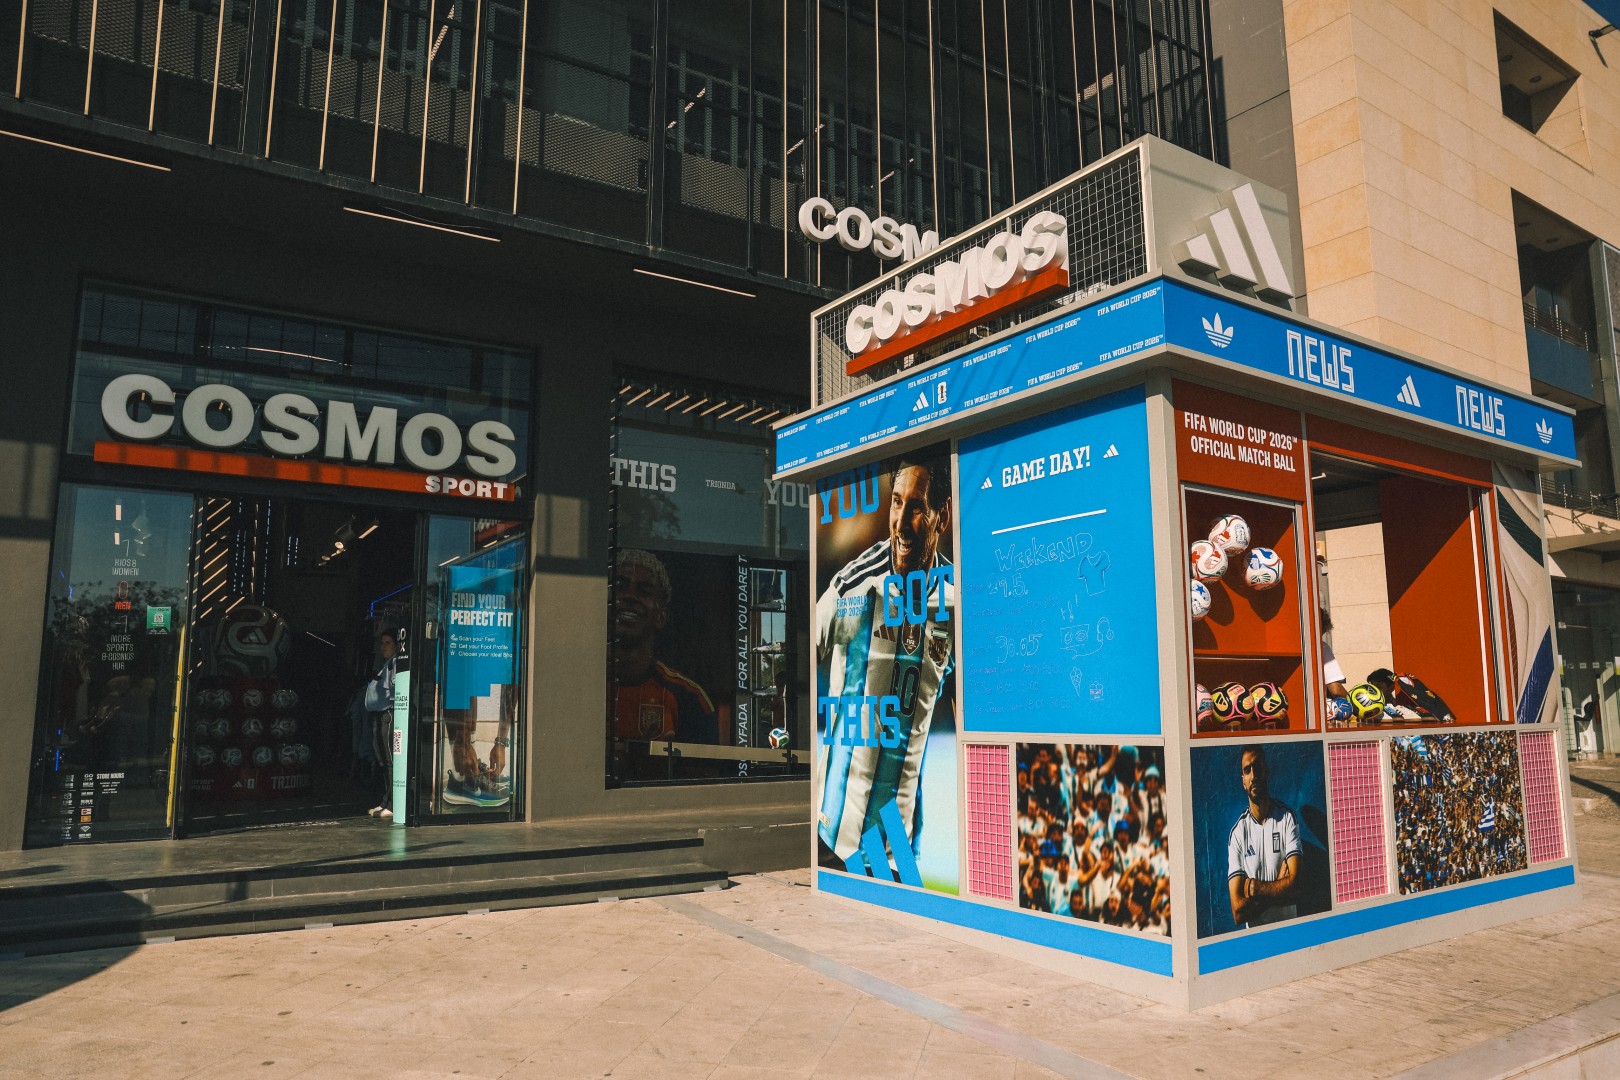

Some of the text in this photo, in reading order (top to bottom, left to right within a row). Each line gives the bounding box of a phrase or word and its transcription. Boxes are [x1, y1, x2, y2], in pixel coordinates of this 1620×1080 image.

[798, 196, 958, 261] COSM
[846, 210, 1069, 354] COSMOS
[1097, 305, 1109, 316] FIFA
[1110, 297, 1129, 311] WORLD
[1130, 293, 1140, 304] CUP
[1025, 333, 1036, 344] FIFA
[1037, 327, 1053, 339] WORLD
[1054, 323, 1063, 333] CUP
[1099, 351, 1111, 361] FIFA
[1112, 344, 1131, 357] WORLD
[1132, 340, 1143, 351] CUP
[1028, 376, 1037, 385] FIFA
[1038, 370, 1054, 382] WORLD
[1056, 367, 1065, 376] CUP
[1286, 329, 1506, 437] NEWS NEWS
[100, 373, 517, 478] COSMOS
[1184, 411, 1207, 432] FIFA
[1208, 416, 1245, 440] WORLD
[1247, 426, 1267, 444] CUP
[1002, 444, 1090, 488] GAME DAY!
[1190, 436, 1296, 472] OFFICIAL MATCH BALL
[424, 475, 509, 499] SPORT
[610, 456, 677, 493] THIS
[705, 479, 736, 490] TRIONDA
[764, 478, 810, 508] YOU
[818, 461, 881, 525] YOU
[112, 567, 139, 576] WOMEN
[738, 566, 748, 602] DARE
[115, 601, 132, 610] MEN
[452, 592, 506, 609] FIND YOUR
[848, 596, 868, 606] WORLD
[882, 565, 955, 627] GOT
[450, 610, 513, 627] PERFECT FIT
[738, 605, 748, 632] YOU
[738, 635, 748, 660] ALL
[738, 662, 748, 689] FOR
[818, 695, 900, 749] THIS
